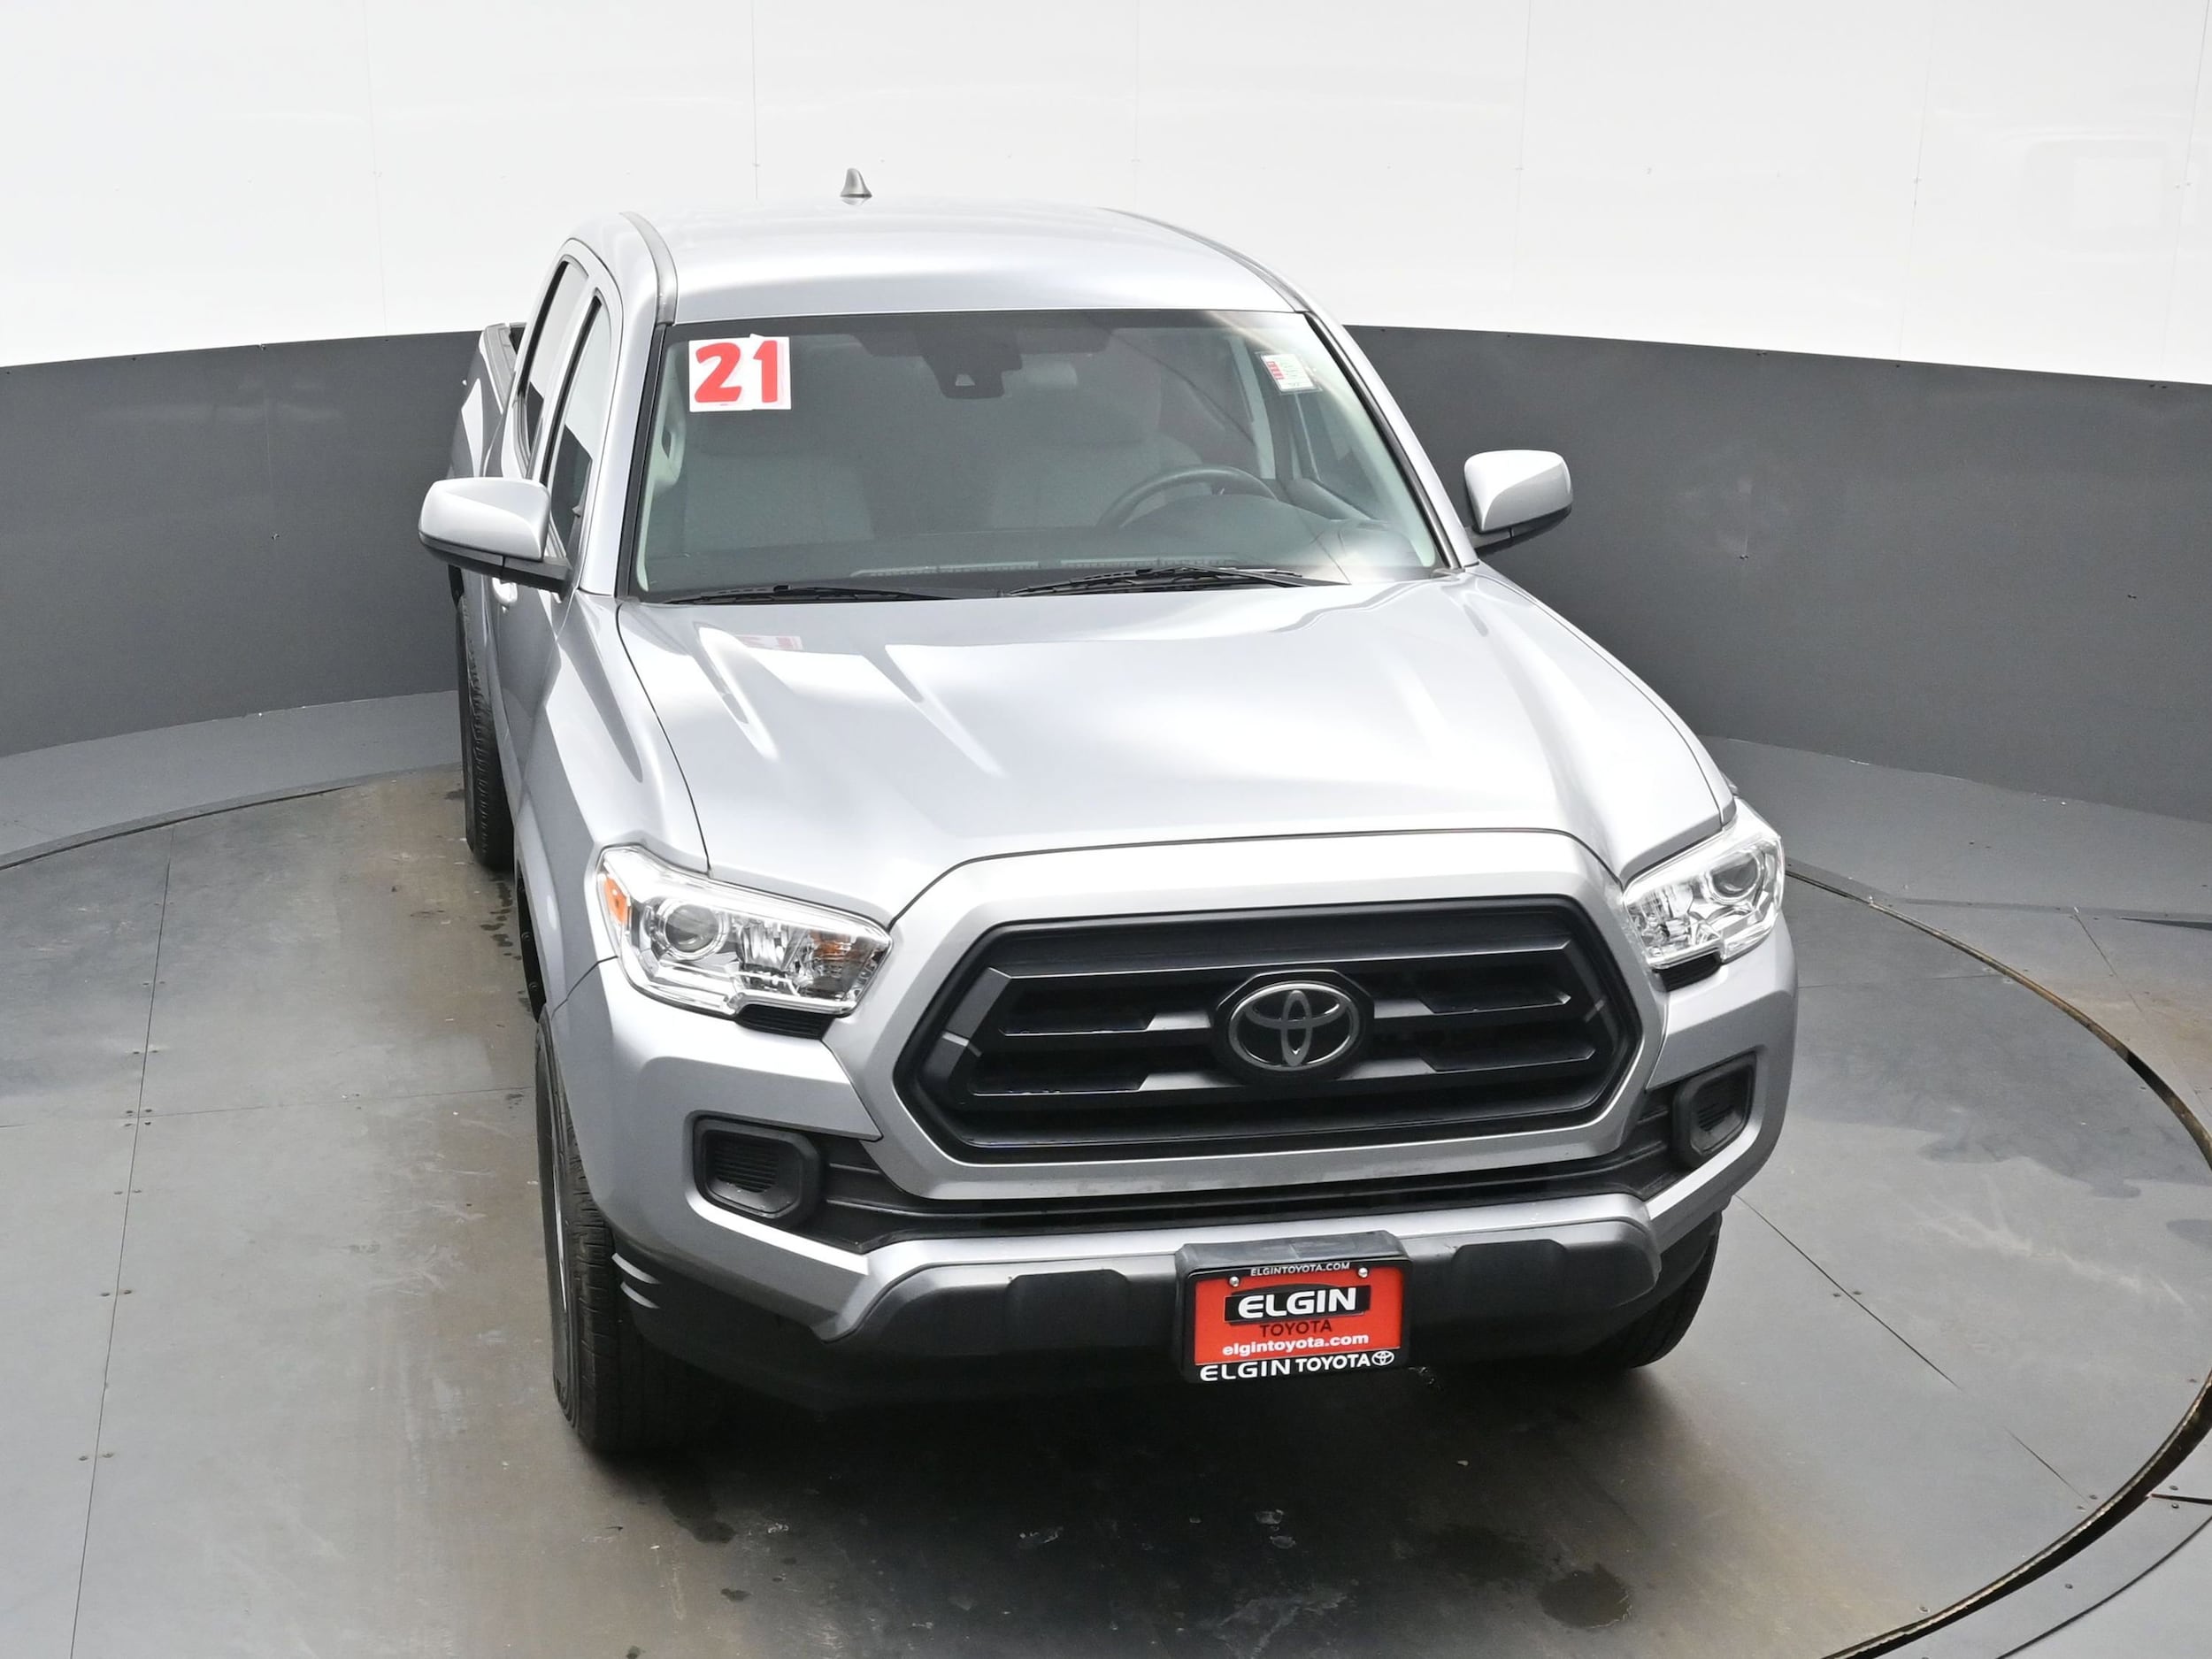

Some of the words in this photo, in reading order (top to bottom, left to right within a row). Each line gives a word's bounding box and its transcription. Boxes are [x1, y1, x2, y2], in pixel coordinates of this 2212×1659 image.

[694, 340, 779, 403] 21
[1249, 1262, 1350, 1277] ELGINTOYOTA.COM
[1238, 1287, 1357, 1318] ELGIN
[1259, 1319, 1333, 1338] TOYOTA
[1222, 1333, 1369, 1357] elgintoyota.com
[1200, 1358, 1290, 1382] ELGIN
[1295, 1353, 1371, 1372] TOYOTA
